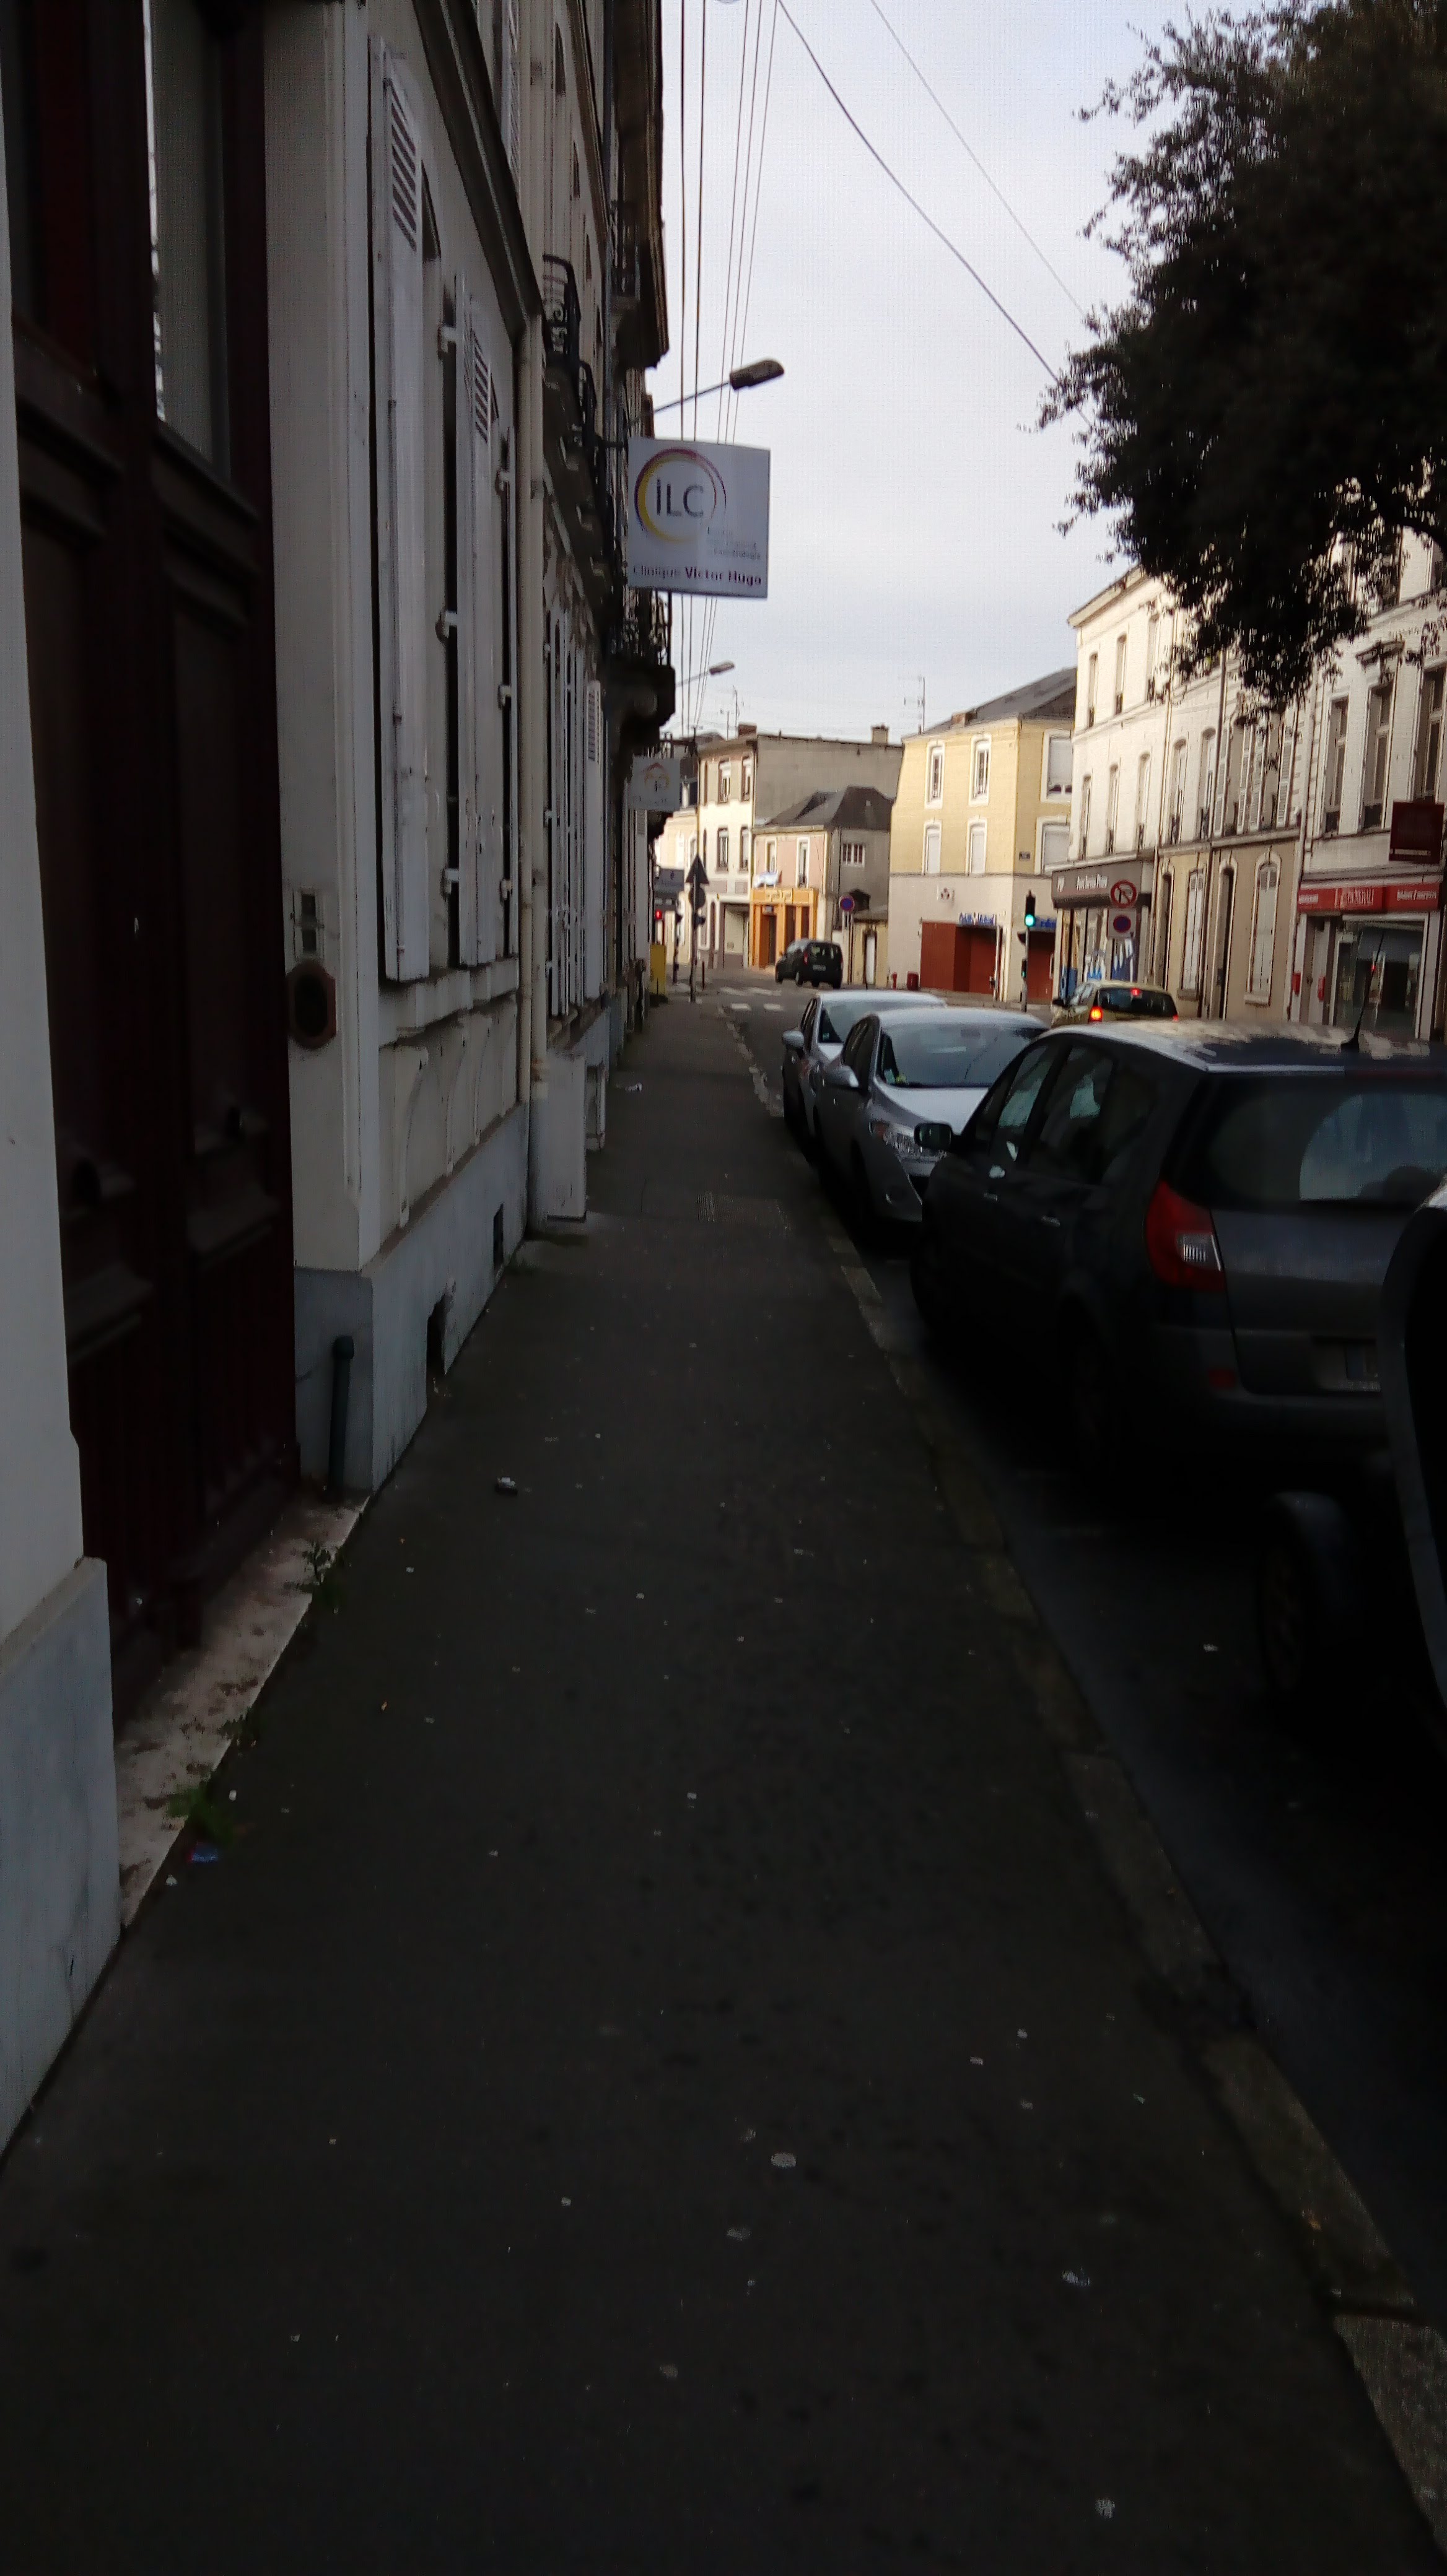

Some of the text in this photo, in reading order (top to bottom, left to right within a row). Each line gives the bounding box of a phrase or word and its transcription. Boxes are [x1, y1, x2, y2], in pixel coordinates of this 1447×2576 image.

[632, 564, 762, 586] Clinique Victor Hugo
